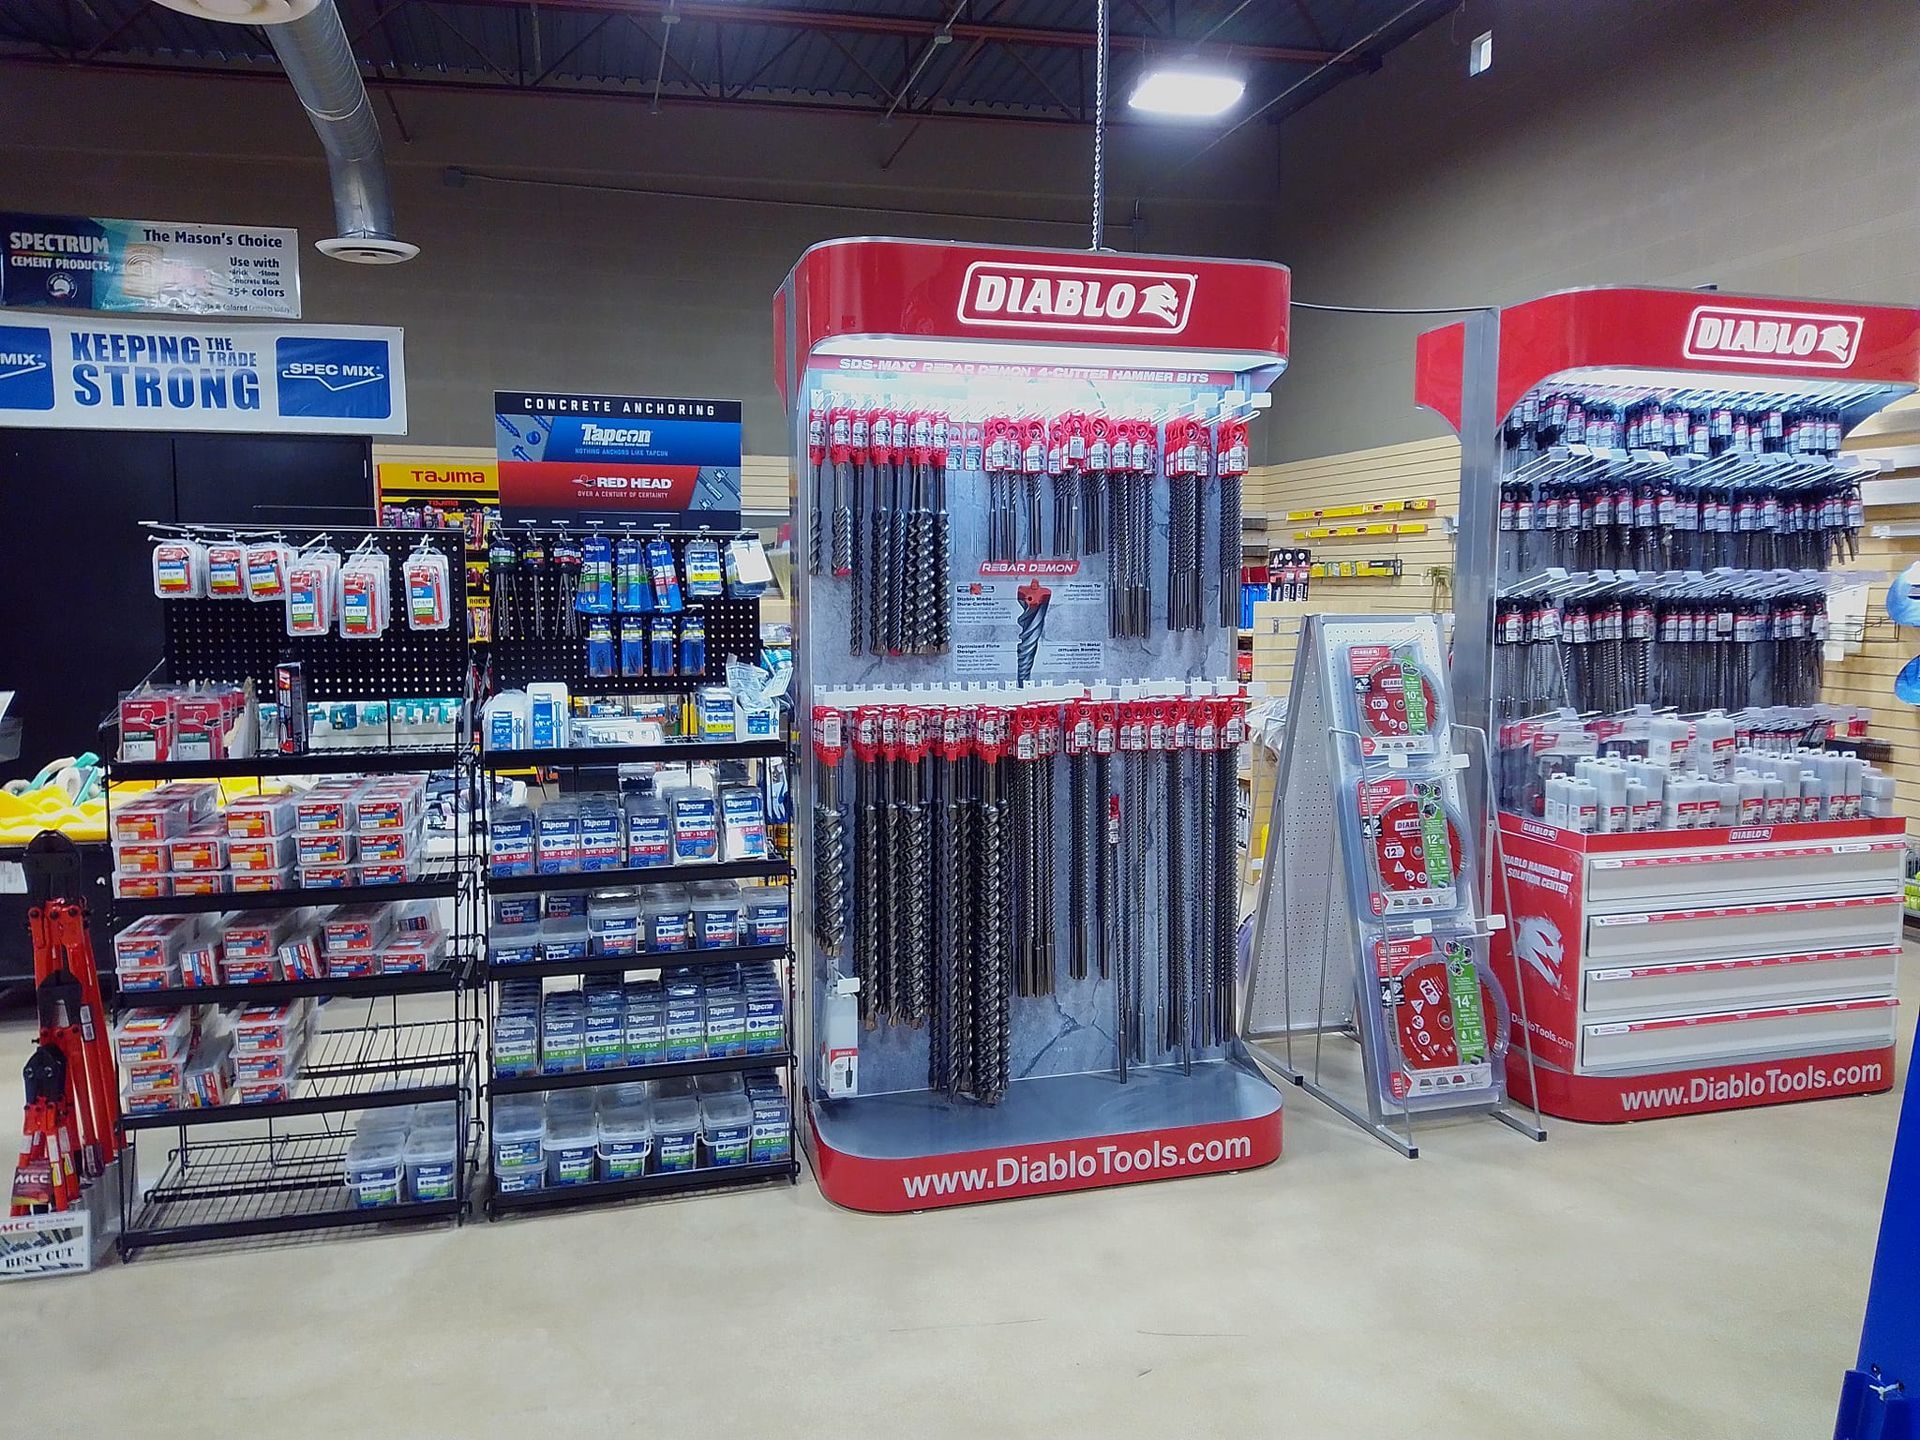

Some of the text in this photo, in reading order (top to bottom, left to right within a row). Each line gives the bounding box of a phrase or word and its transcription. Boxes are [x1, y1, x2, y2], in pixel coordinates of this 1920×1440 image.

[10, 231, 109, 254] SPECTRUM
[143, 229, 283, 248] The Mason's Choice
[11, 255, 110, 272] CEMENT PRODUCTS
[230, 257, 280, 268] Use with
[228, 287, 285, 298] 25+ colors
[975, 275, 1136, 319] DIABLO
[1696, 317, 1818, 355] DIABLO
[71, 332, 233, 366] KEEPING THE
[0, 352, 37, 366] MIX
[207, 351, 257, 367] TRADE
[289, 362, 376, 377] SPEC MIX
[1038, 367, 1109, 380] 4-CUTTER
[1113, 370, 1173, 382] HAMMER
[1177, 373, 1209, 383] BITS
[72, 364, 261, 410] STRONG
[524, 398, 715, 416] CONCRETE ANCHORING
[581, 423, 652, 446] Tapcon
[602, 448, 629, 456] ANCHORS
[597, 477, 672, 489] RED HEAD
[982, 563, 1073, 573] REBAR DEMON
[679, 803, 705, 811] Tapcon
[542, 820, 569, 829] Tapcon
[583, 819, 610, 828] Tapcon
[632, 817, 659, 825] Tapcon
[493, 824, 521, 833] Tapcon
[1523, 822, 1549, 836] DIABLO
[1732, 830, 1762, 840] DIABLO
[1528, 860, 1560, 880] HAMMER
[1560, 870, 1574, 883] BIT
[1507, 867, 1569, 895] SOLUTION CENTER
[709, 1007, 735, 1015] Tapcon
[749, 1003, 774, 1011] Tapcon
[628, 1015, 655, 1023] Tapcon
[669, 1010, 695, 1018] Tapcon
[547, 1022, 574, 1030] Tapcon
[588, 1017, 614, 1025] Tapcon
[497, 1029, 525, 1037] Tapcon
[1621, 1061, 1882, 1111] www.DiabloTools.com
[756, 1111, 780, 1119] Tapcon
[903, 1136, 1251, 1199] www.DiabloTools.com
[15, 1175, 49, 1184] MCC
[6, 1247, 74, 1268] BEST CUT
